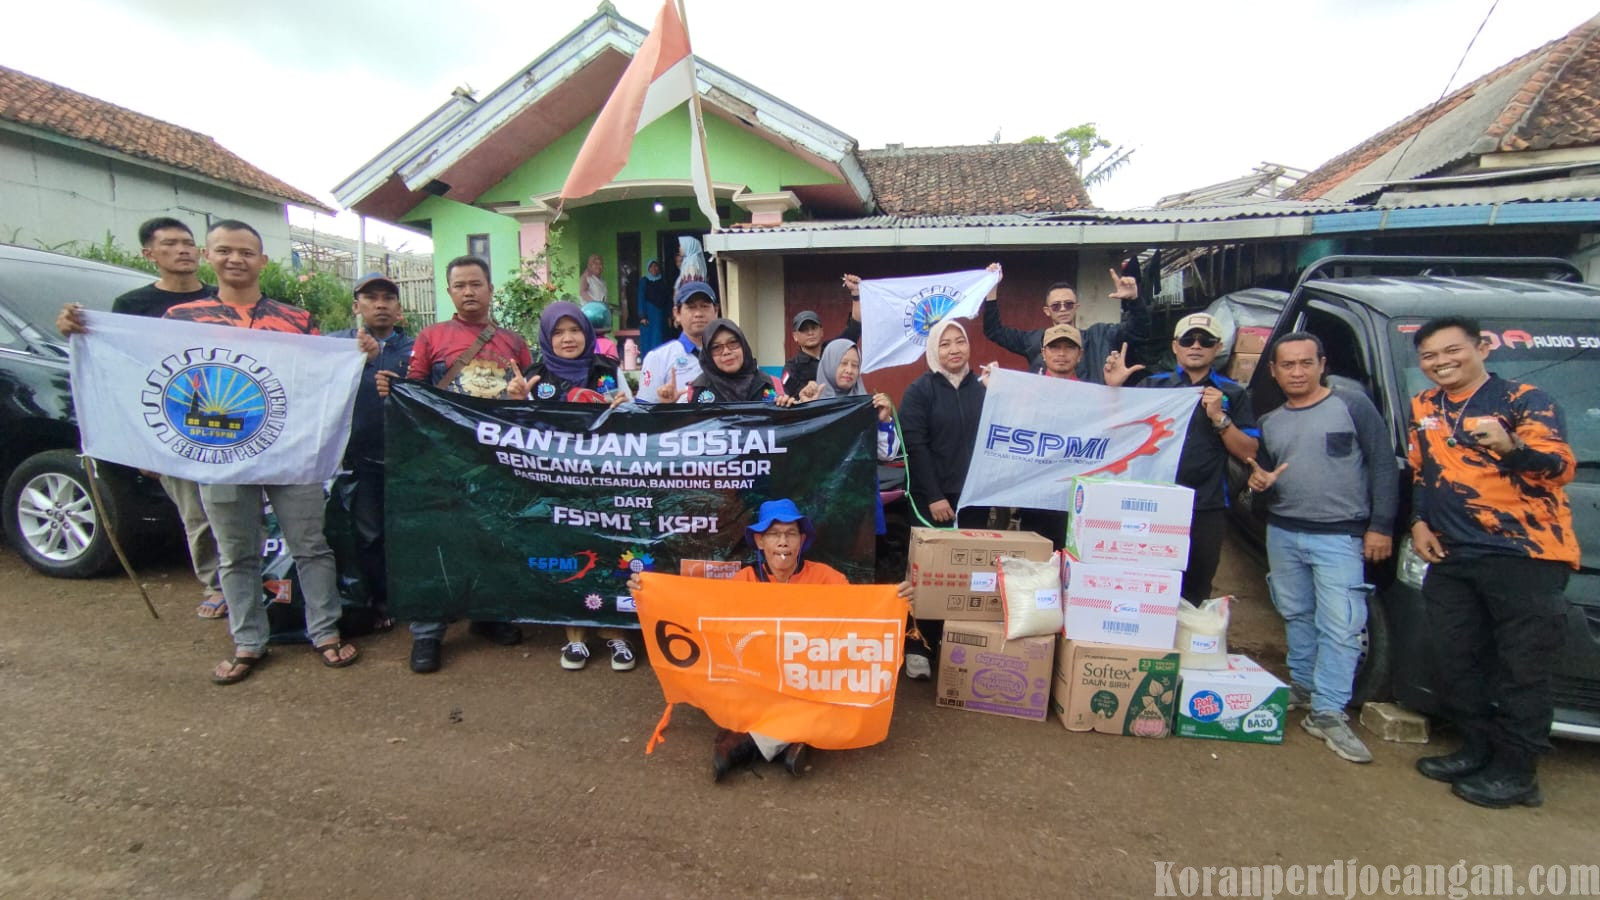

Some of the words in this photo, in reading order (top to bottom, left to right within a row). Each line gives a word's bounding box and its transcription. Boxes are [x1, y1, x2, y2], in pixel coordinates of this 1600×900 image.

[1533, 336, 1576, 348] AUDIO
[477, 421, 647, 457] BANTUAN
[658, 429, 787, 457] SOSIAL
[985, 423, 1110, 459] FSPMI
[496, 451, 594, 474] BENCANA
[600, 460, 662, 476] ALAM
[669, 460, 771, 476] LONGSOR
[714, 479, 755, 489] BARAT
[614, 496, 653, 508] DARI
[553, 506, 632, 531] FSPMI
[658, 515, 718, 534] KSPI
[528, 557, 578, 571] FSPMI
[655, 619, 700, 668] 6
[783, 631, 894, 662] Partai
[784, 663, 892, 693] Buruh
[1083, 662, 1134, 680] Softex
[1082, 678, 1106, 687] DAUN
[1108, 681, 1130, 689] SIRIH
[1247, 718, 1274, 729] BASO
